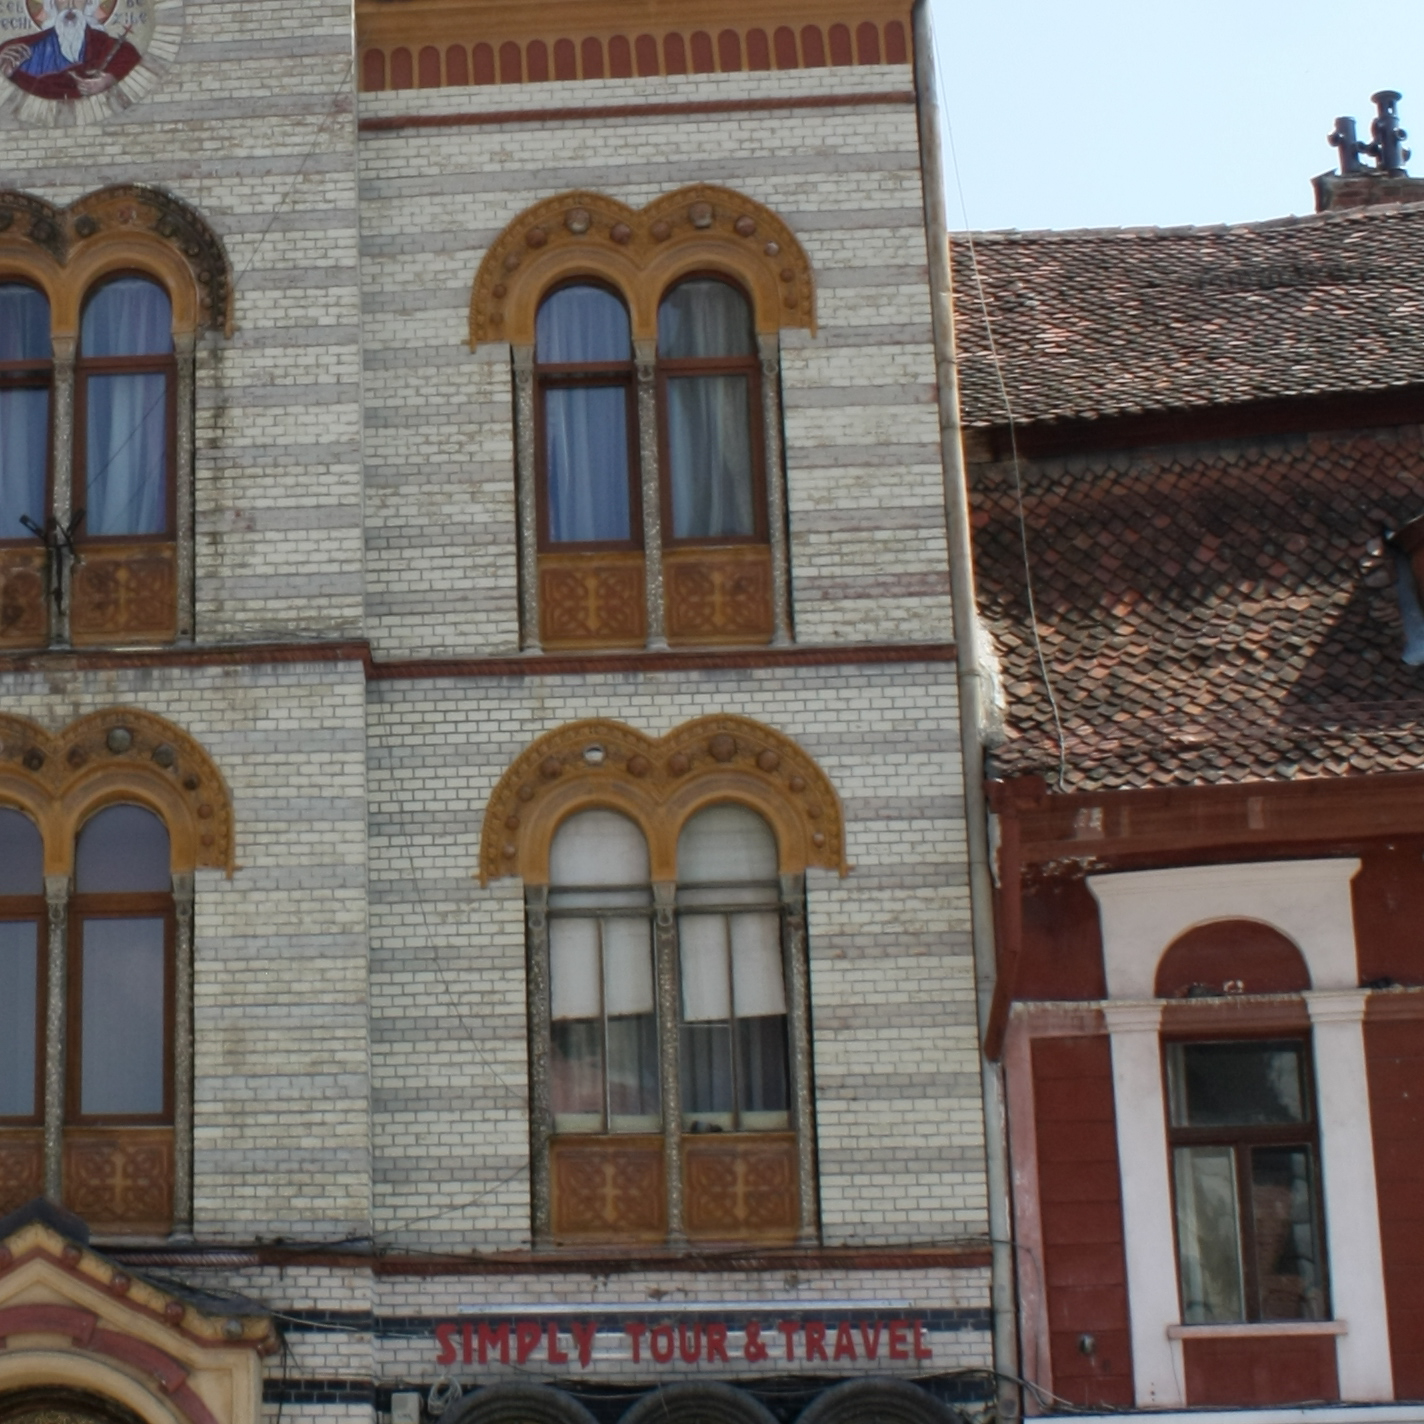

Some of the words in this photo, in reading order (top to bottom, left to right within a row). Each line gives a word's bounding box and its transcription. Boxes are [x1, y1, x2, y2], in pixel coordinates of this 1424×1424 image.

[435, 1321, 597, 1369] SIMPLY
[624, 1320, 729, 1365] TOUR
[744, 1319, 769, 1363] &
[778, 1318, 932, 1362] TRAVEL
